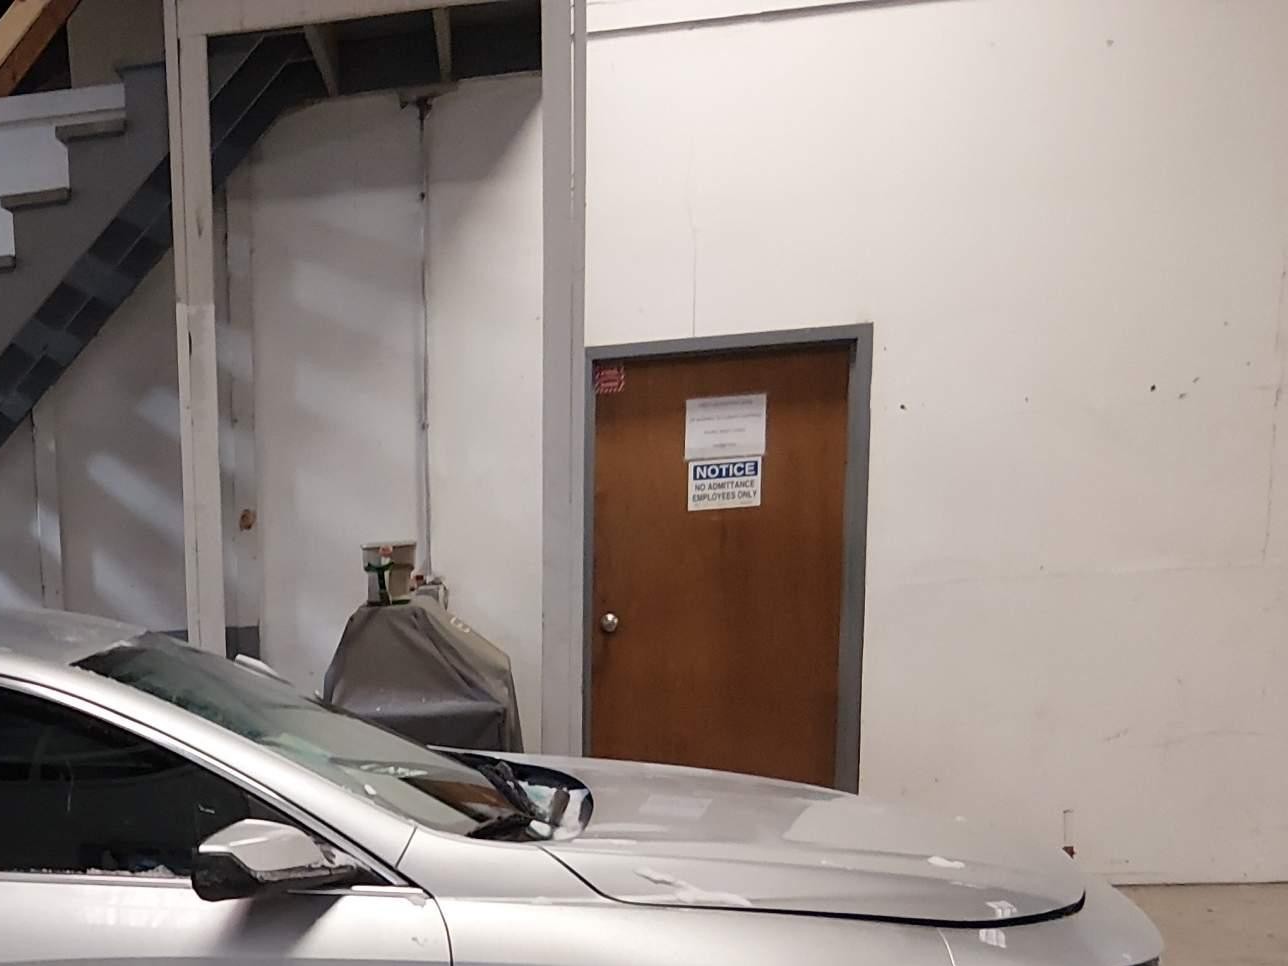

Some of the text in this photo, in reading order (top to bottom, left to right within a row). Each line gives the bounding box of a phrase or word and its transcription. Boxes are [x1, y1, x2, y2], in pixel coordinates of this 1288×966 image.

[696, 462, 755, 478] NOTICE
[694, 480, 755, 491] NO ADMITTANCE
[692, 490, 757, 502] EMPLOYEES ONLY
